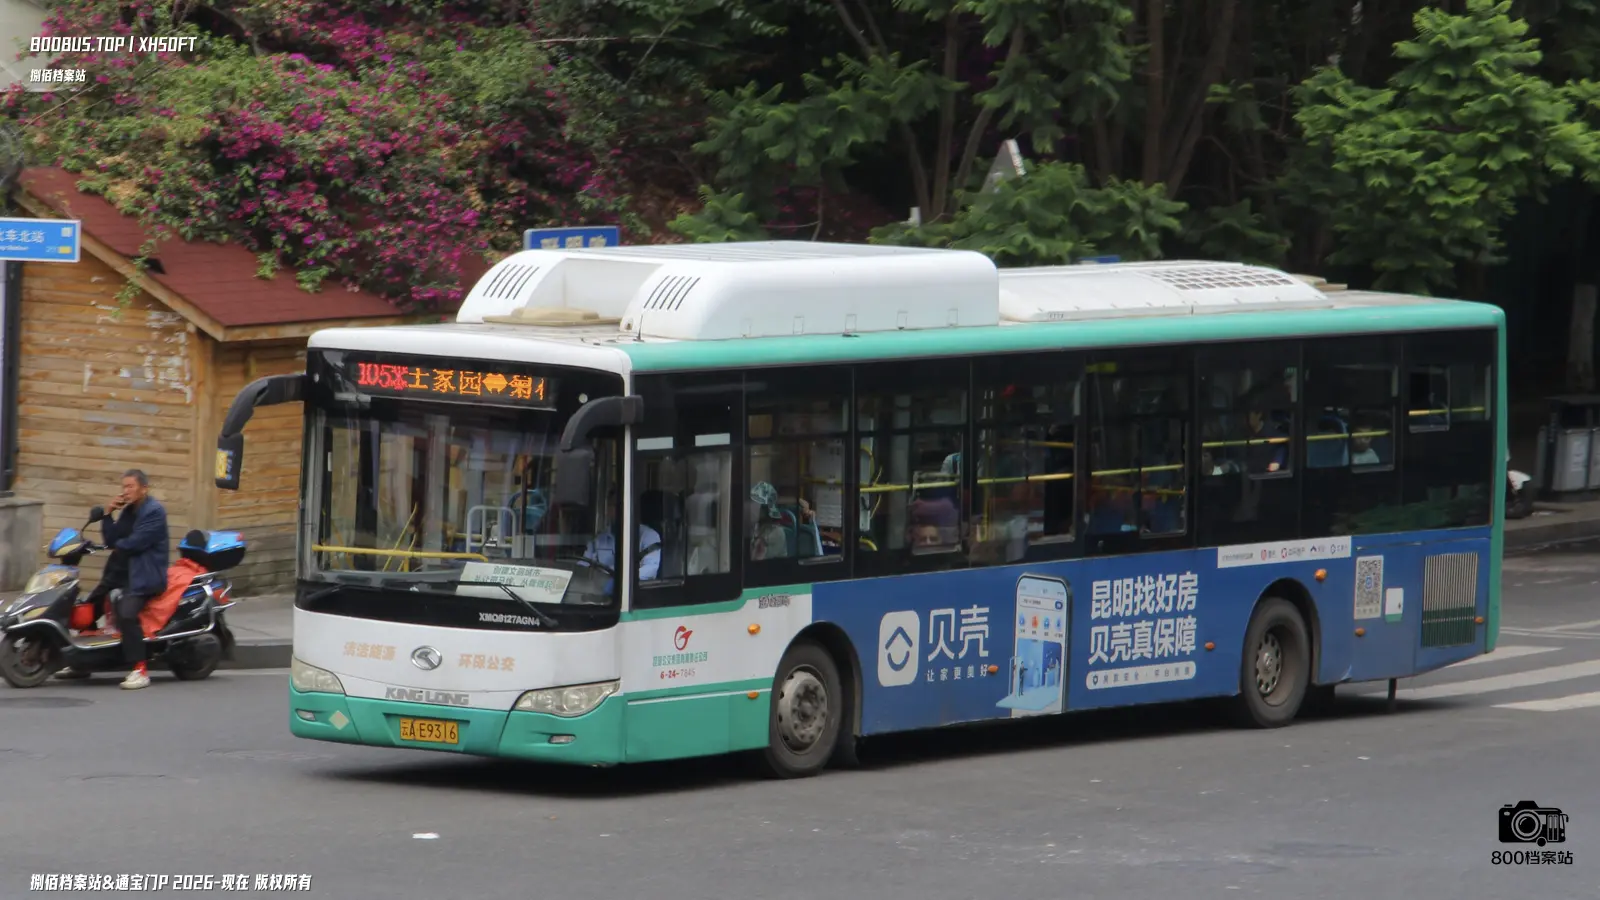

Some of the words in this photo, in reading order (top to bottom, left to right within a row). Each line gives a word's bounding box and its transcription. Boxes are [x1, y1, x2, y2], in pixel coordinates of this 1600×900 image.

[1091, 570, 1199, 620] 昆明找好房
[927, 604, 990, 662] 贝壳
[1088, 614, 1197, 665] 贝壳真保障
[344, 642, 396, 661] 清洁能源
[459, 653, 516, 671] 环保公交
[926, 663, 989, 682] 让家更美好
[385, 687, 422, 701] KING
[425, 693, 470, 706] LONG
